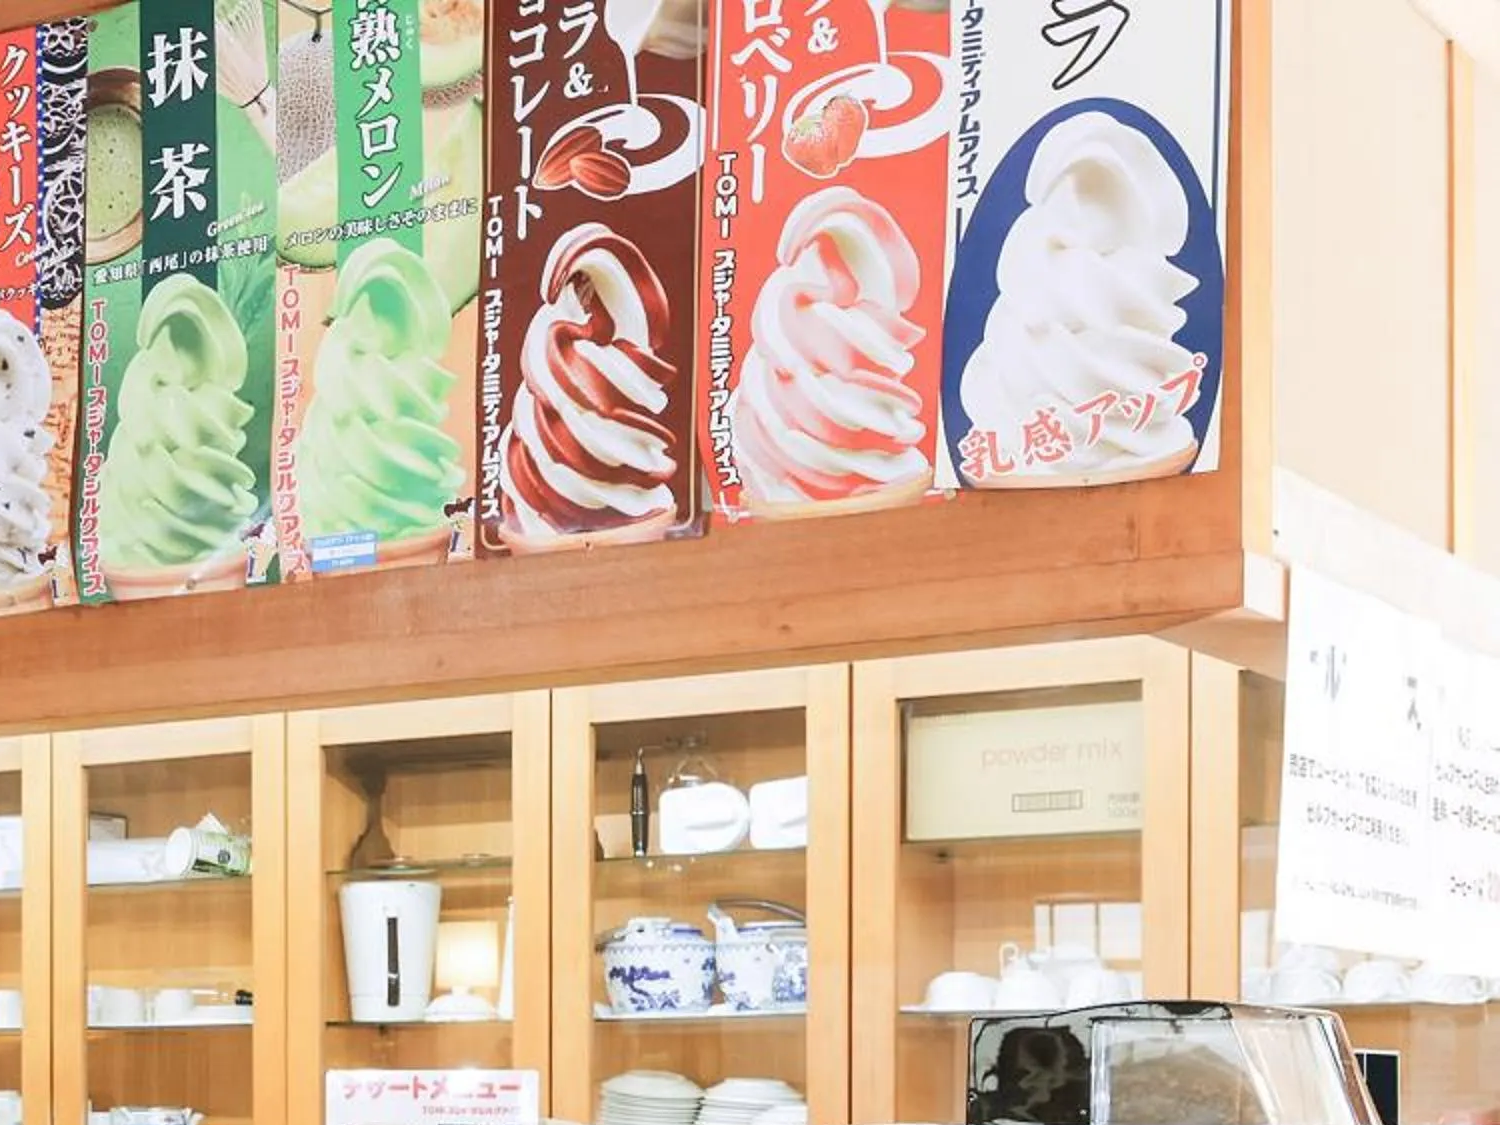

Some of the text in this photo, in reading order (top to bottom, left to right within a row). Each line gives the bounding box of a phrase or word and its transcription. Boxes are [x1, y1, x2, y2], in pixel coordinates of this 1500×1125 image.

[0, 42, 34, 253] クッキーズ
[146, 27, 211, 221] 抹茶
[485, 195, 504, 279] TOMI
[714, 152, 740, 240] TOMI
[88, 300, 108, 382] TOMI
[281, 266, 300, 353] TOMI
[958, 352, 1209, 480] 乳感アップ
[981, 738, 1123, 771] powder mix
